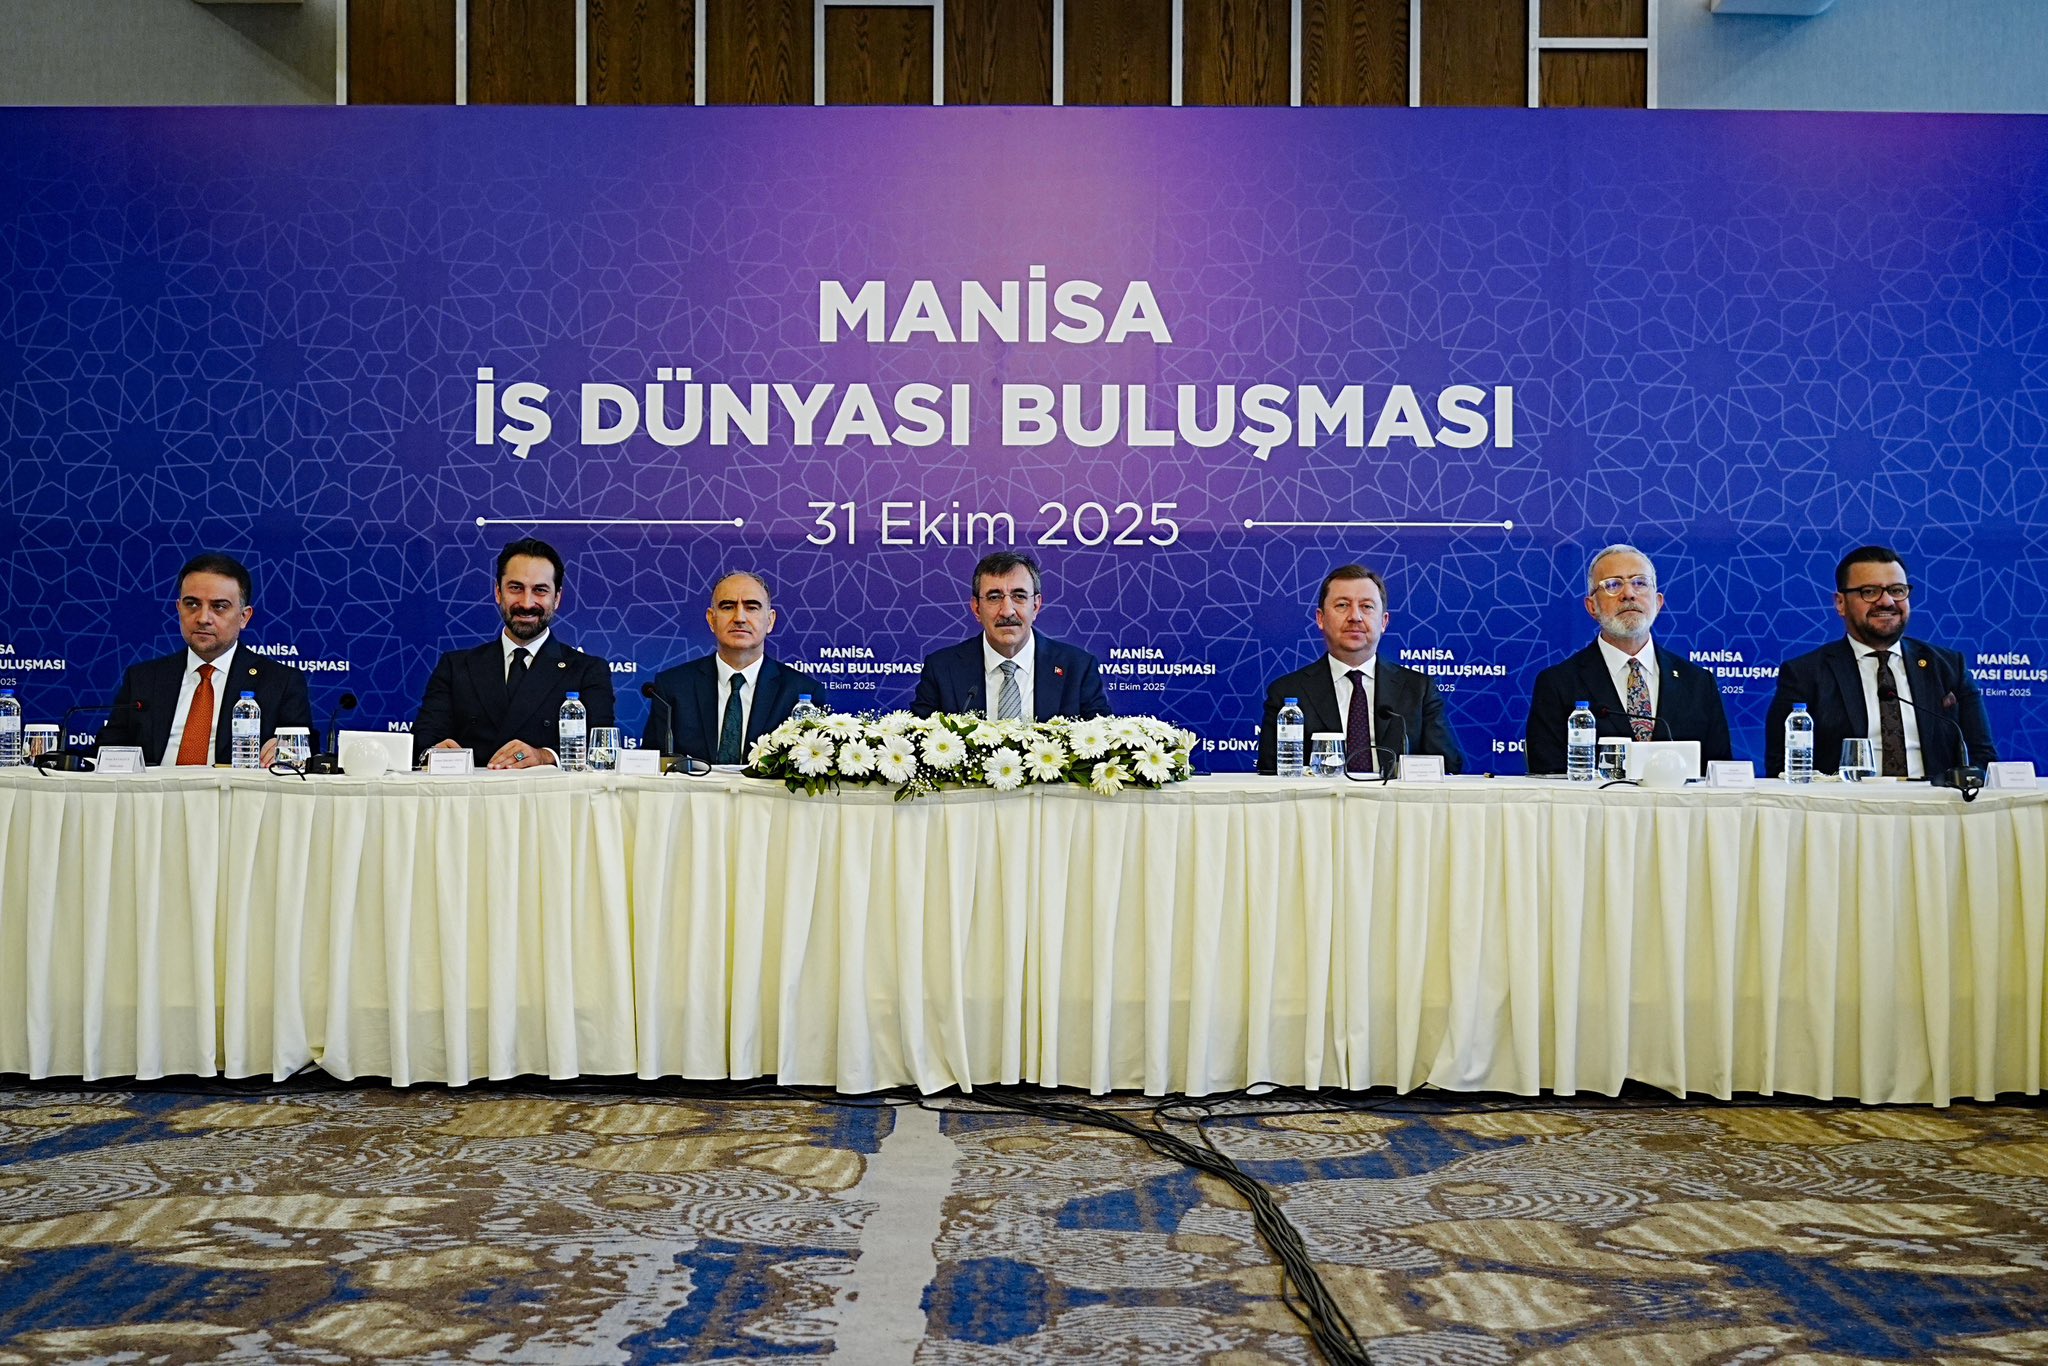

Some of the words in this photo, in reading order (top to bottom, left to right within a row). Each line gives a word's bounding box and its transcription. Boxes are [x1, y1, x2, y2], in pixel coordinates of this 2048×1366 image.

[820, 264, 1173, 344] MANİSA
[475, 367, 552, 460] İŞ
[580, 367, 970, 447] DÜNYASI
[1001, 383, 1513, 462] BULUŞMASI
[807, 501, 856, 545] 31
[881, 501, 1015, 545] Ekim
[1037, 501, 1179, 546] 2025
[820, 646, 875, 658] MANİSA
[1110, 646, 1164, 659] MANİSA
[1400, 647, 1454, 660] MANİSA
[1689, 649, 1743, 662] MANİSA
[1977, 651, 2031, 665] MANİSA
[0, 659, 66, 671] ULUŞMASI
[1137, 664, 1216, 676] BULUŞMASI
[1427, 665, 1506, 677] BULUŞMASI
[1717, 667, 1780, 679] BULUŞMA
[2004, 669, 2048, 682] BULUŞ
[0, 678, 17, 686] 025
[853, 682, 876, 690] 2025
[1108, 683, 1117, 691] 31
[1119, 682, 1141, 691] Ekim
[1143, 683, 1166, 691] 2025
[1436, 684, 1455, 692] 025
[1721, 686, 1744, 694] 2025
[1986, 688, 2008, 696] Ekim
[2009, 688, 2032, 697] 2025
[624, 736, 637, 749] İŞ
[1203, 738, 1215, 752] İŞ
[1219, 738, 1259, 751] DÜNY
[1493, 739, 1505, 753] İŞ
